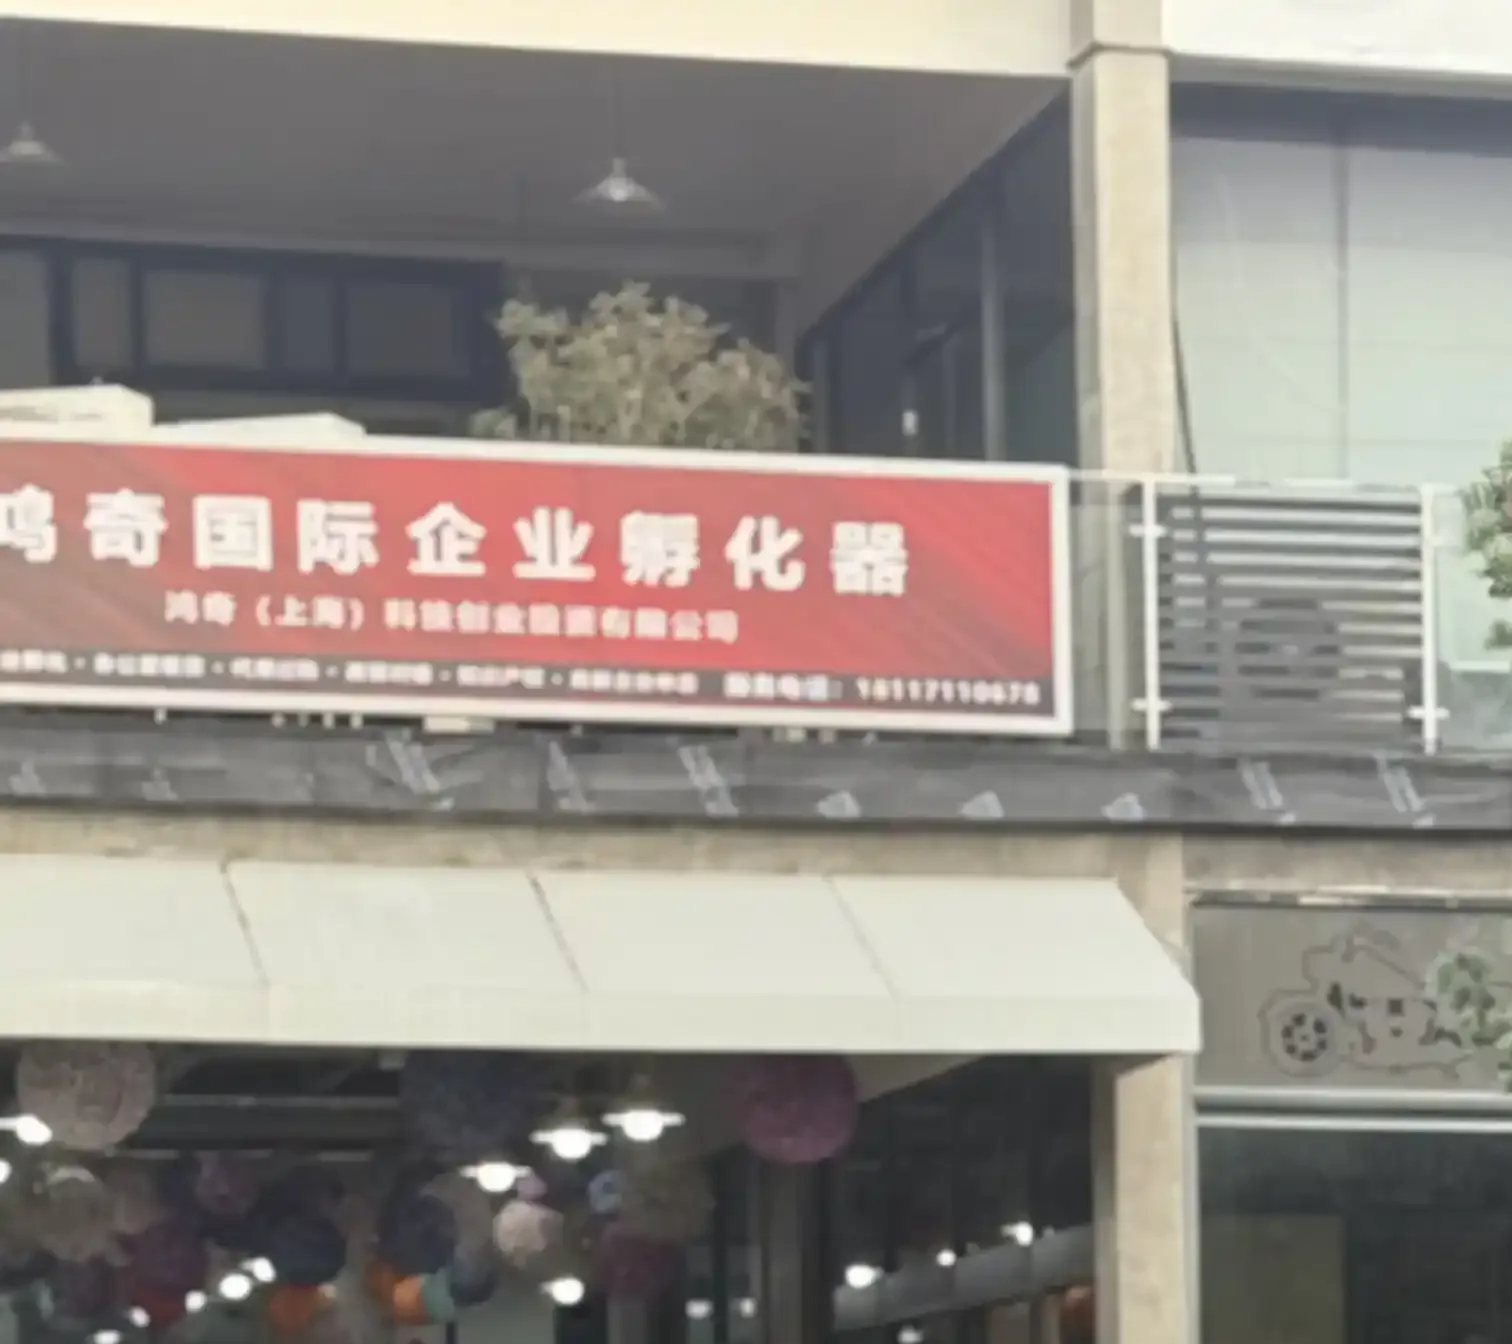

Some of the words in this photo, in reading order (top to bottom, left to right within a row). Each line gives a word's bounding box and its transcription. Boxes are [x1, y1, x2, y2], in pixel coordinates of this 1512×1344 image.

[0, 483, 908, 597] 鸿奇国际企业孵化器
